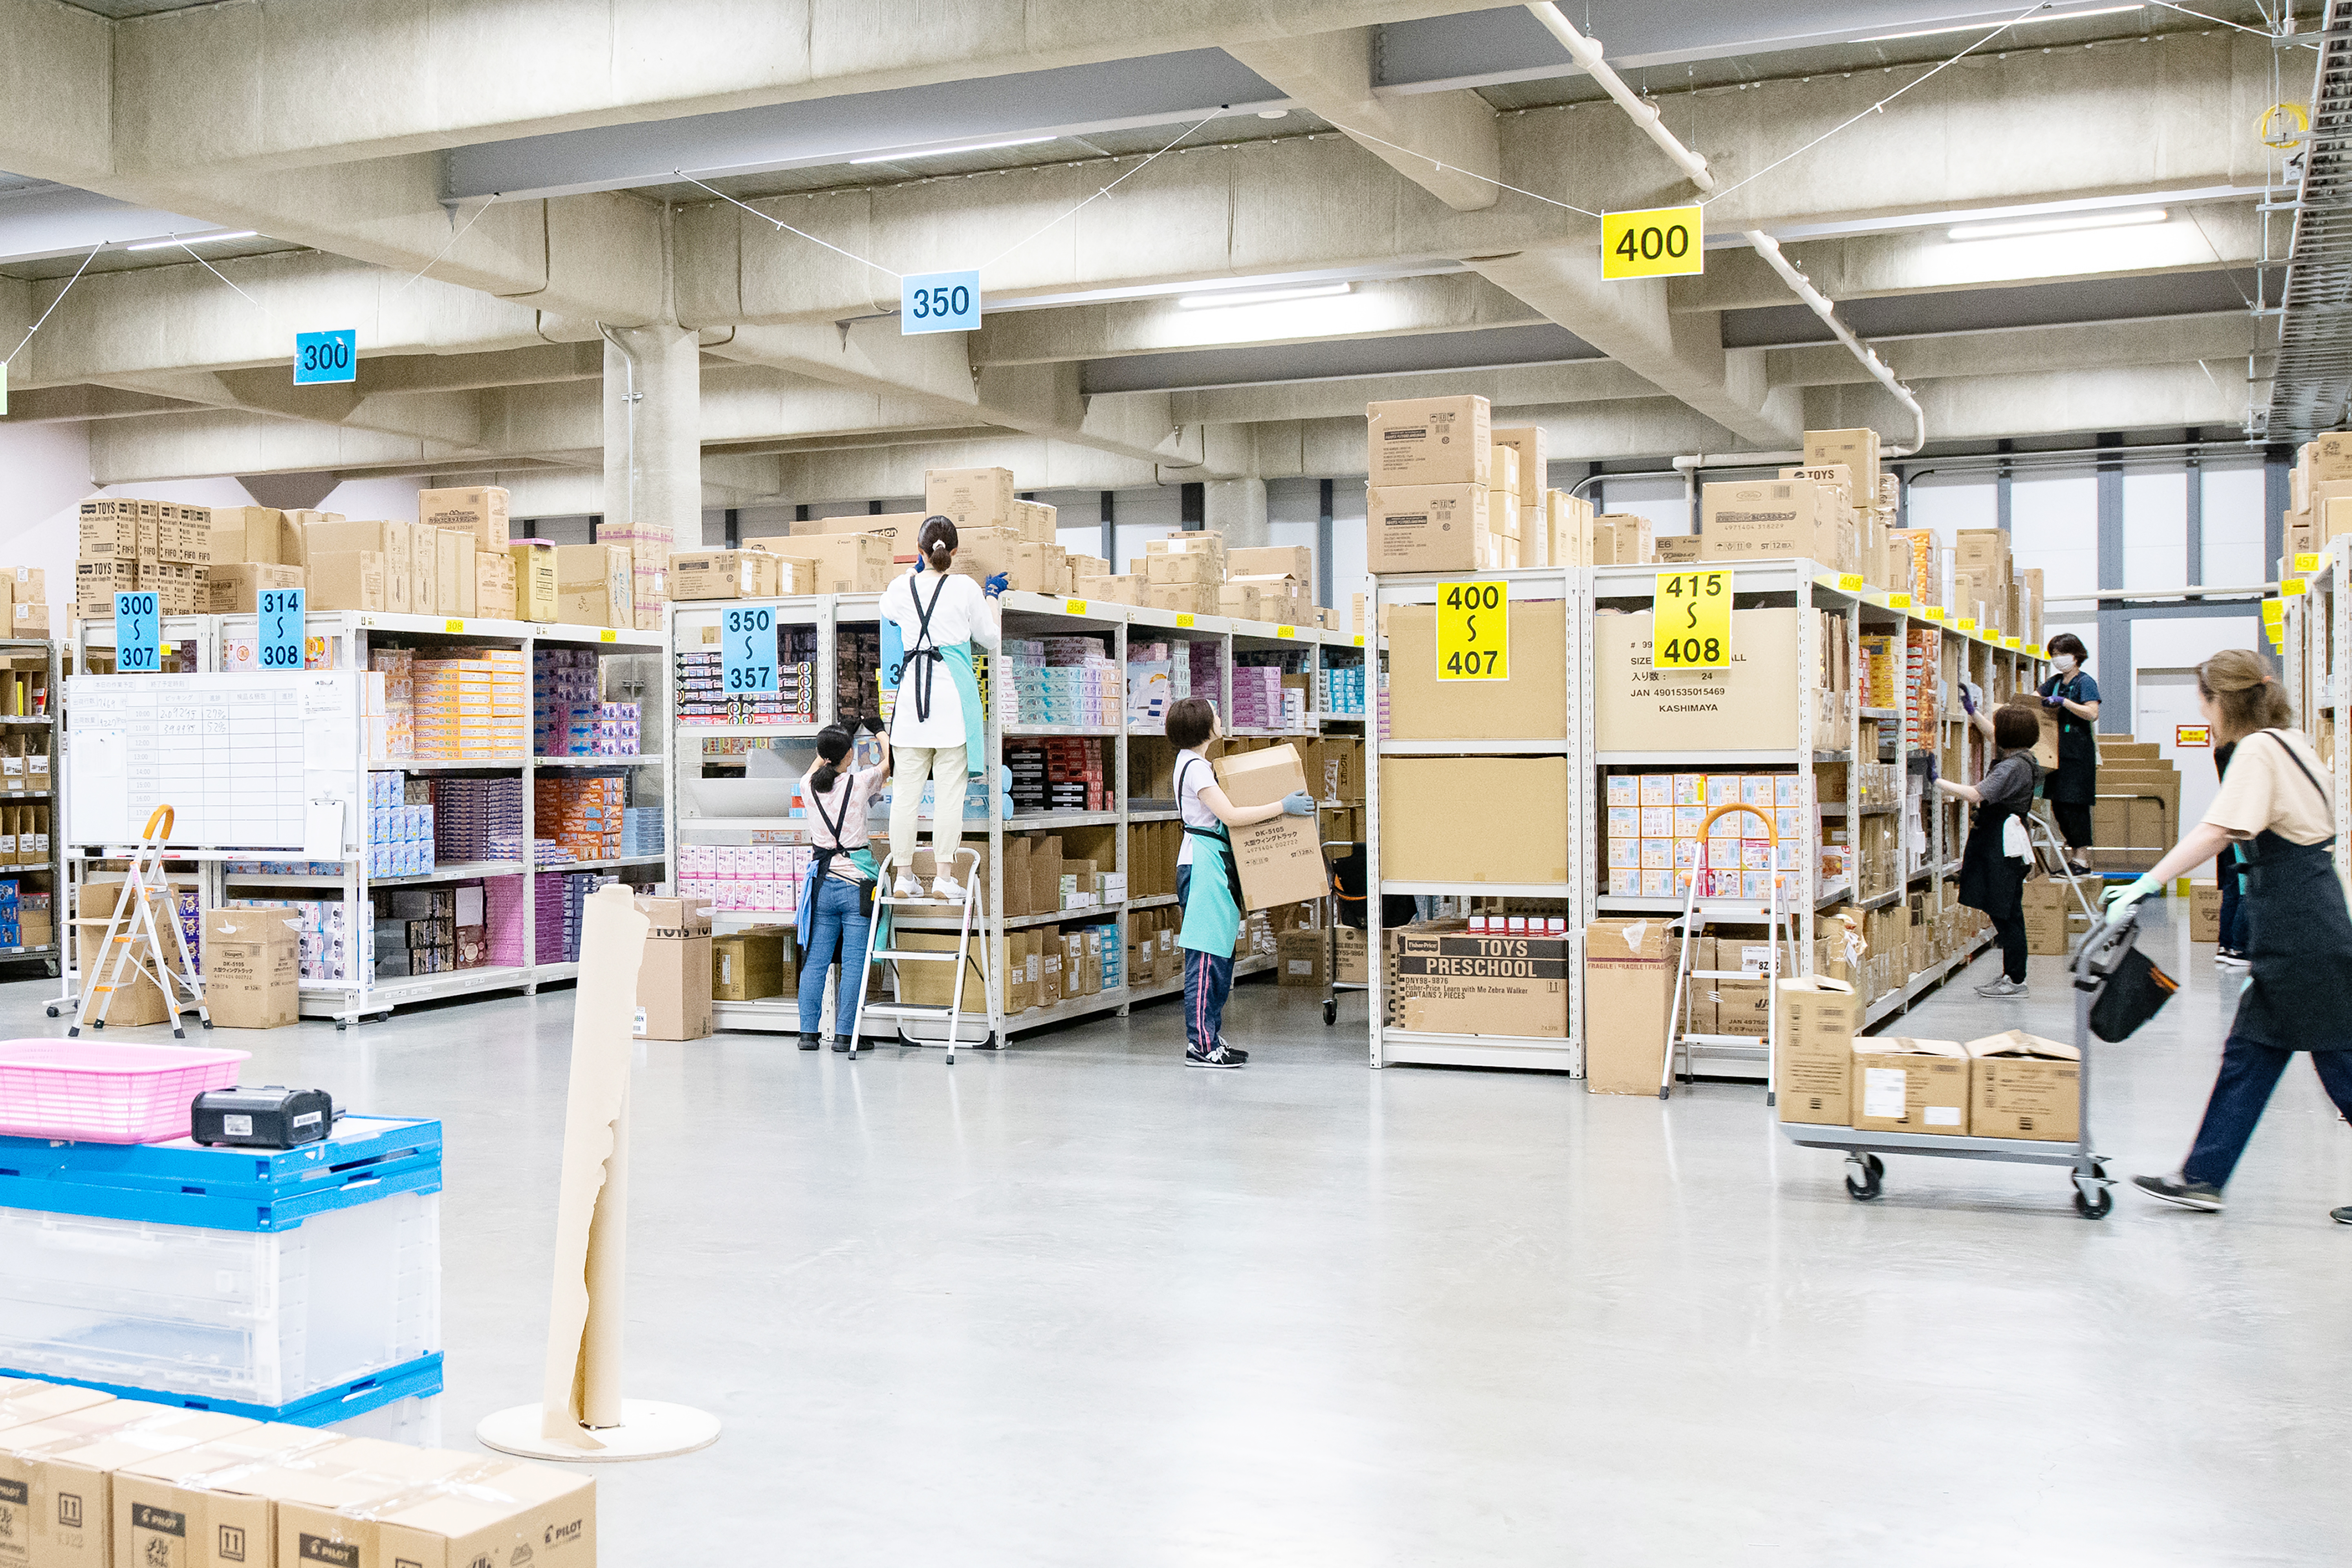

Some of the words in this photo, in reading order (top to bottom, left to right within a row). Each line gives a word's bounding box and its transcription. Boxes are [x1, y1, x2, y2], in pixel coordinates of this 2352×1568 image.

[1616, 225, 1688, 261] 400
[913, 286, 969, 318] 350
[305, 342, 348, 370] 300
[1808, 470, 1834, 480] TOYS
[98, 502, 115, 514] TOYS
[122, 545, 134, 554] FIFO
[144, 547, 156, 555] FIFO
[165, 549, 176, 557] FIFO
[184, 551, 196, 559] FIFO
[199, 552, 210, 560] FIFO
[2296, 556, 2316, 567] 457
[94, 563, 112, 575] TOYS
[1666, 574, 1721, 598] 415
[1840, 577, 1861, 588] 408
[264, 592, 298, 613] 314
[1447, 586, 1499, 610] 400
[1891, 596, 1910, 605] 409
[121, 596, 153, 615] 300
[1068, 602, 1085, 612] 358
[1925, 609, 1944, 618] 410
[447, 621, 463, 631] 308
[729, 610, 769, 632] 350
[601, 631, 616, 642] 309
[122, 647, 154, 667] 307
[264, 646, 298, 666] 308
[1664, 638, 1720, 663] 408
[1447, 651, 1498, 675] 407
[731, 667, 770, 689] 357
[1654, 688, 1725, 696] 4901535015469
[1659, 704, 1718, 712] KASHIMAYA
[1255, 826, 1284, 837] DK-5105
[1244, 832, 1297, 847] 大型ウィングトラック
[1247, 845, 1273, 853] 4971404
[1275, 839, 1298, 848] 002722
[1477, 939, 1528, 957] TOYS
[1426, 957, 1537, 977] PRESCHOOL
[556, 1519, 583, 1541] PILOT
